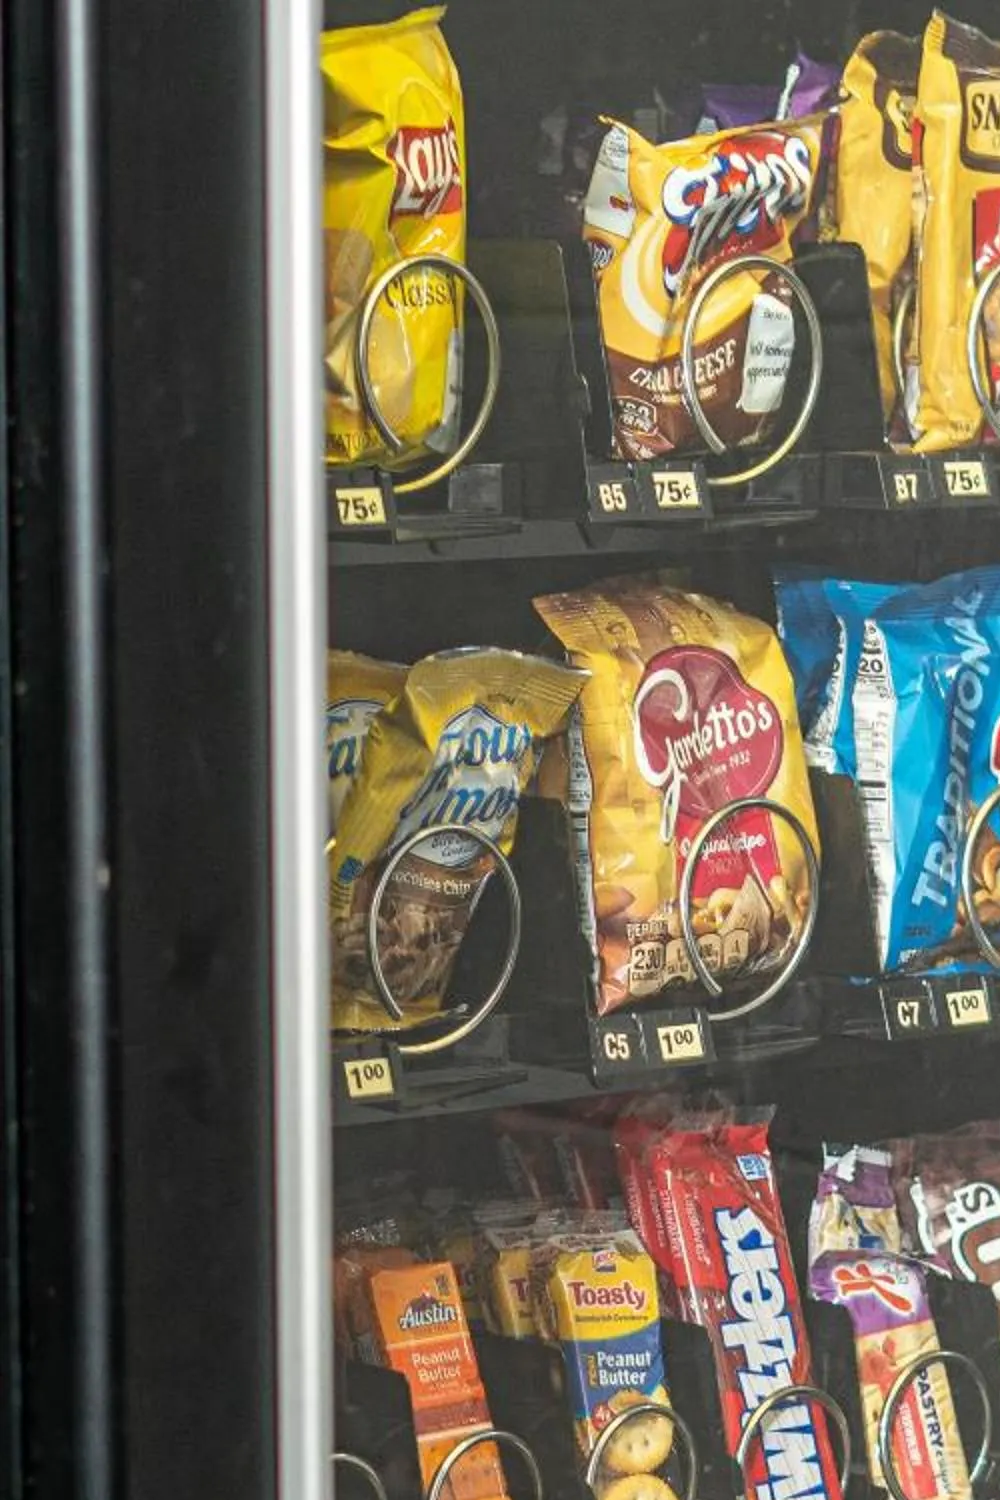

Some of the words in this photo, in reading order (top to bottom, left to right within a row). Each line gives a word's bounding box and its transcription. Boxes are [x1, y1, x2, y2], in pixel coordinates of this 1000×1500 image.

[673, 339, 738, 389] CEESE
[600, 483, 627, 512] B5
[894, 473, 919, 503] B7
[897, 1001, 919, 1027] C7
[604, 1033, 630, 1060] C5
[568, 1281, 647, 1310] Toasty
[400, 1304, 457, 1329] Austin
[597, 1351, 651, 1367] Peanut
[599, 1369, 647, 1386] Butter
[918, 1367, 945, 1447] PASTRY
